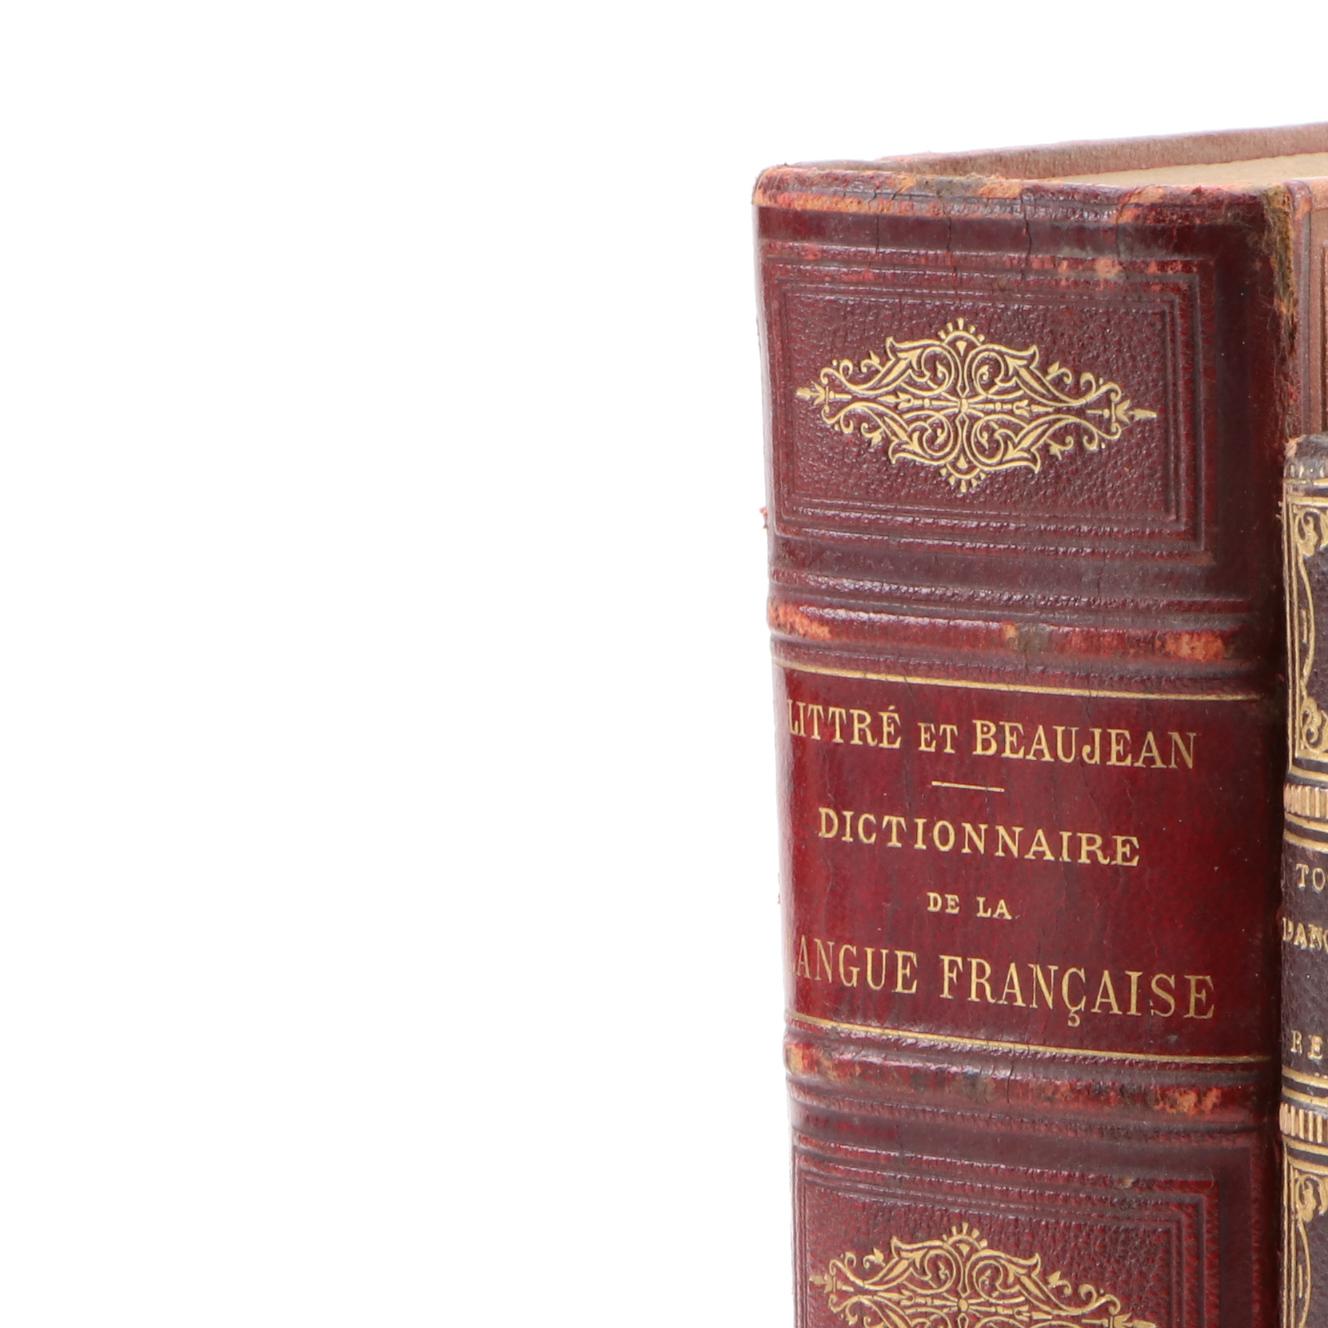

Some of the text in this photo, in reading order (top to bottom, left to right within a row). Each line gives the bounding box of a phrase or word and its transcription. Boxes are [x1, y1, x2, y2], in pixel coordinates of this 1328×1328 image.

[786, 699, 1198, 770] LITTRÉ ET BEAUJEAN
[818, 806, 1141, 867] DICTIONNAIRE
[927, 892, 1013, 920] DE LA
[792, 934, 1216, 1028] ANGUE FRANÇAISE
